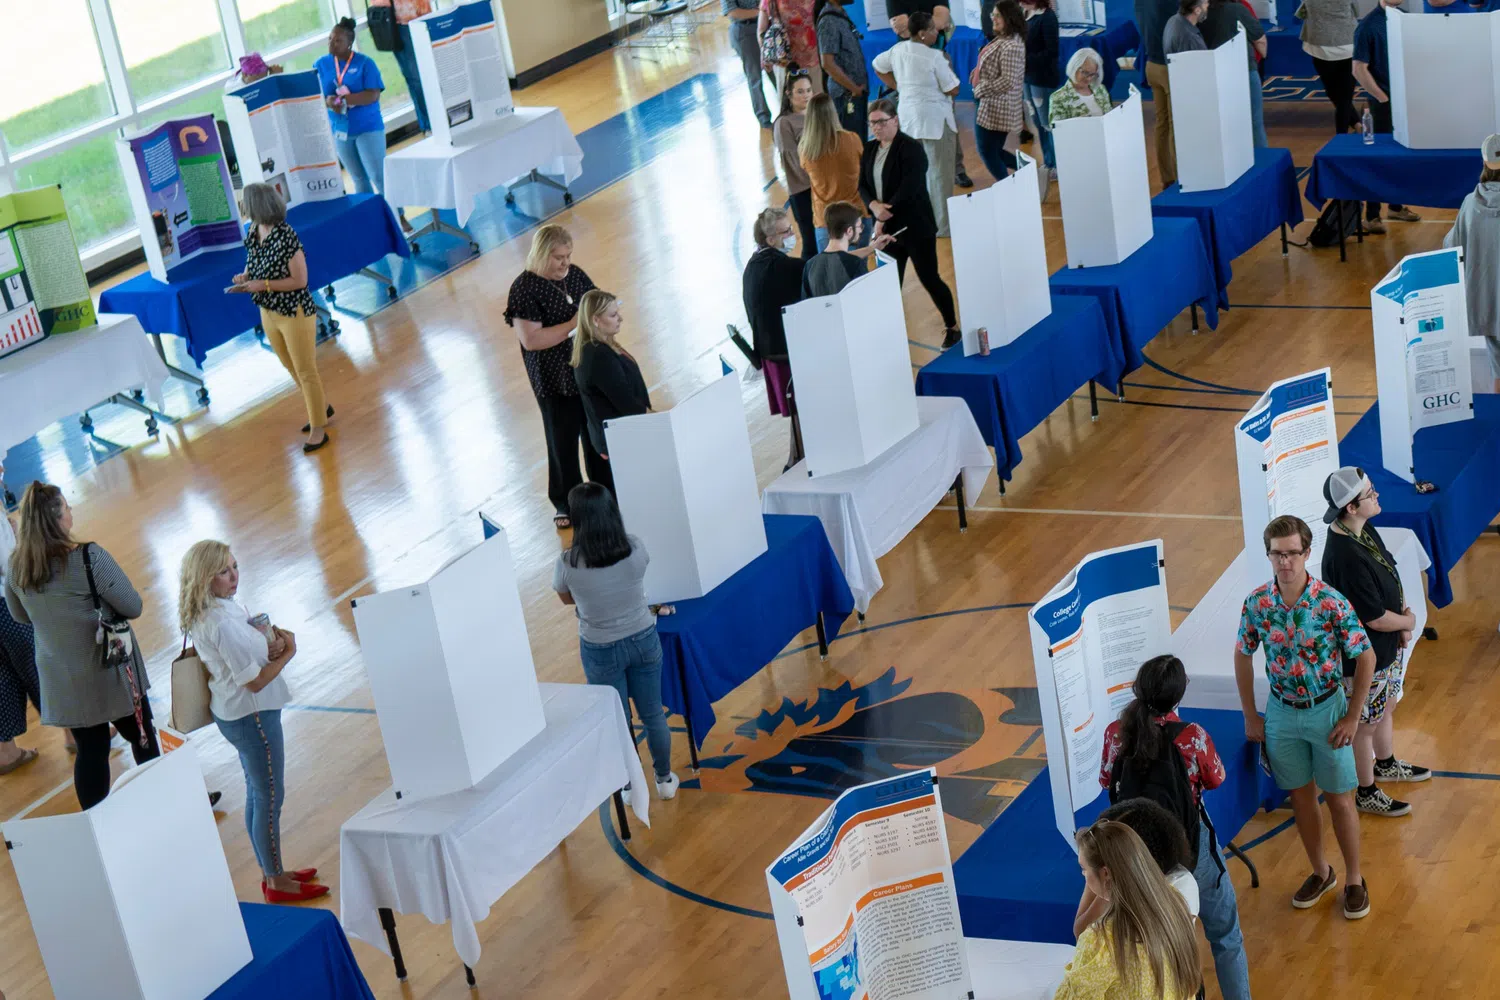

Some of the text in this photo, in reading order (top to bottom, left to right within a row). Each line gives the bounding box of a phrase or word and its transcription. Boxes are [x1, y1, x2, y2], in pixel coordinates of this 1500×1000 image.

[306, 178, 338, 191] GHC
[56, 305, 90, 322] GHC
[1423, 392, 1460, 409] GHC
[1053, 605, 1072, 618] College
[783, 851, 799, 864] Career
[800, 843, 811, 853] Plan
[803, 859, 829, 880] Traditional
[873, 888, 894, 897] Career
